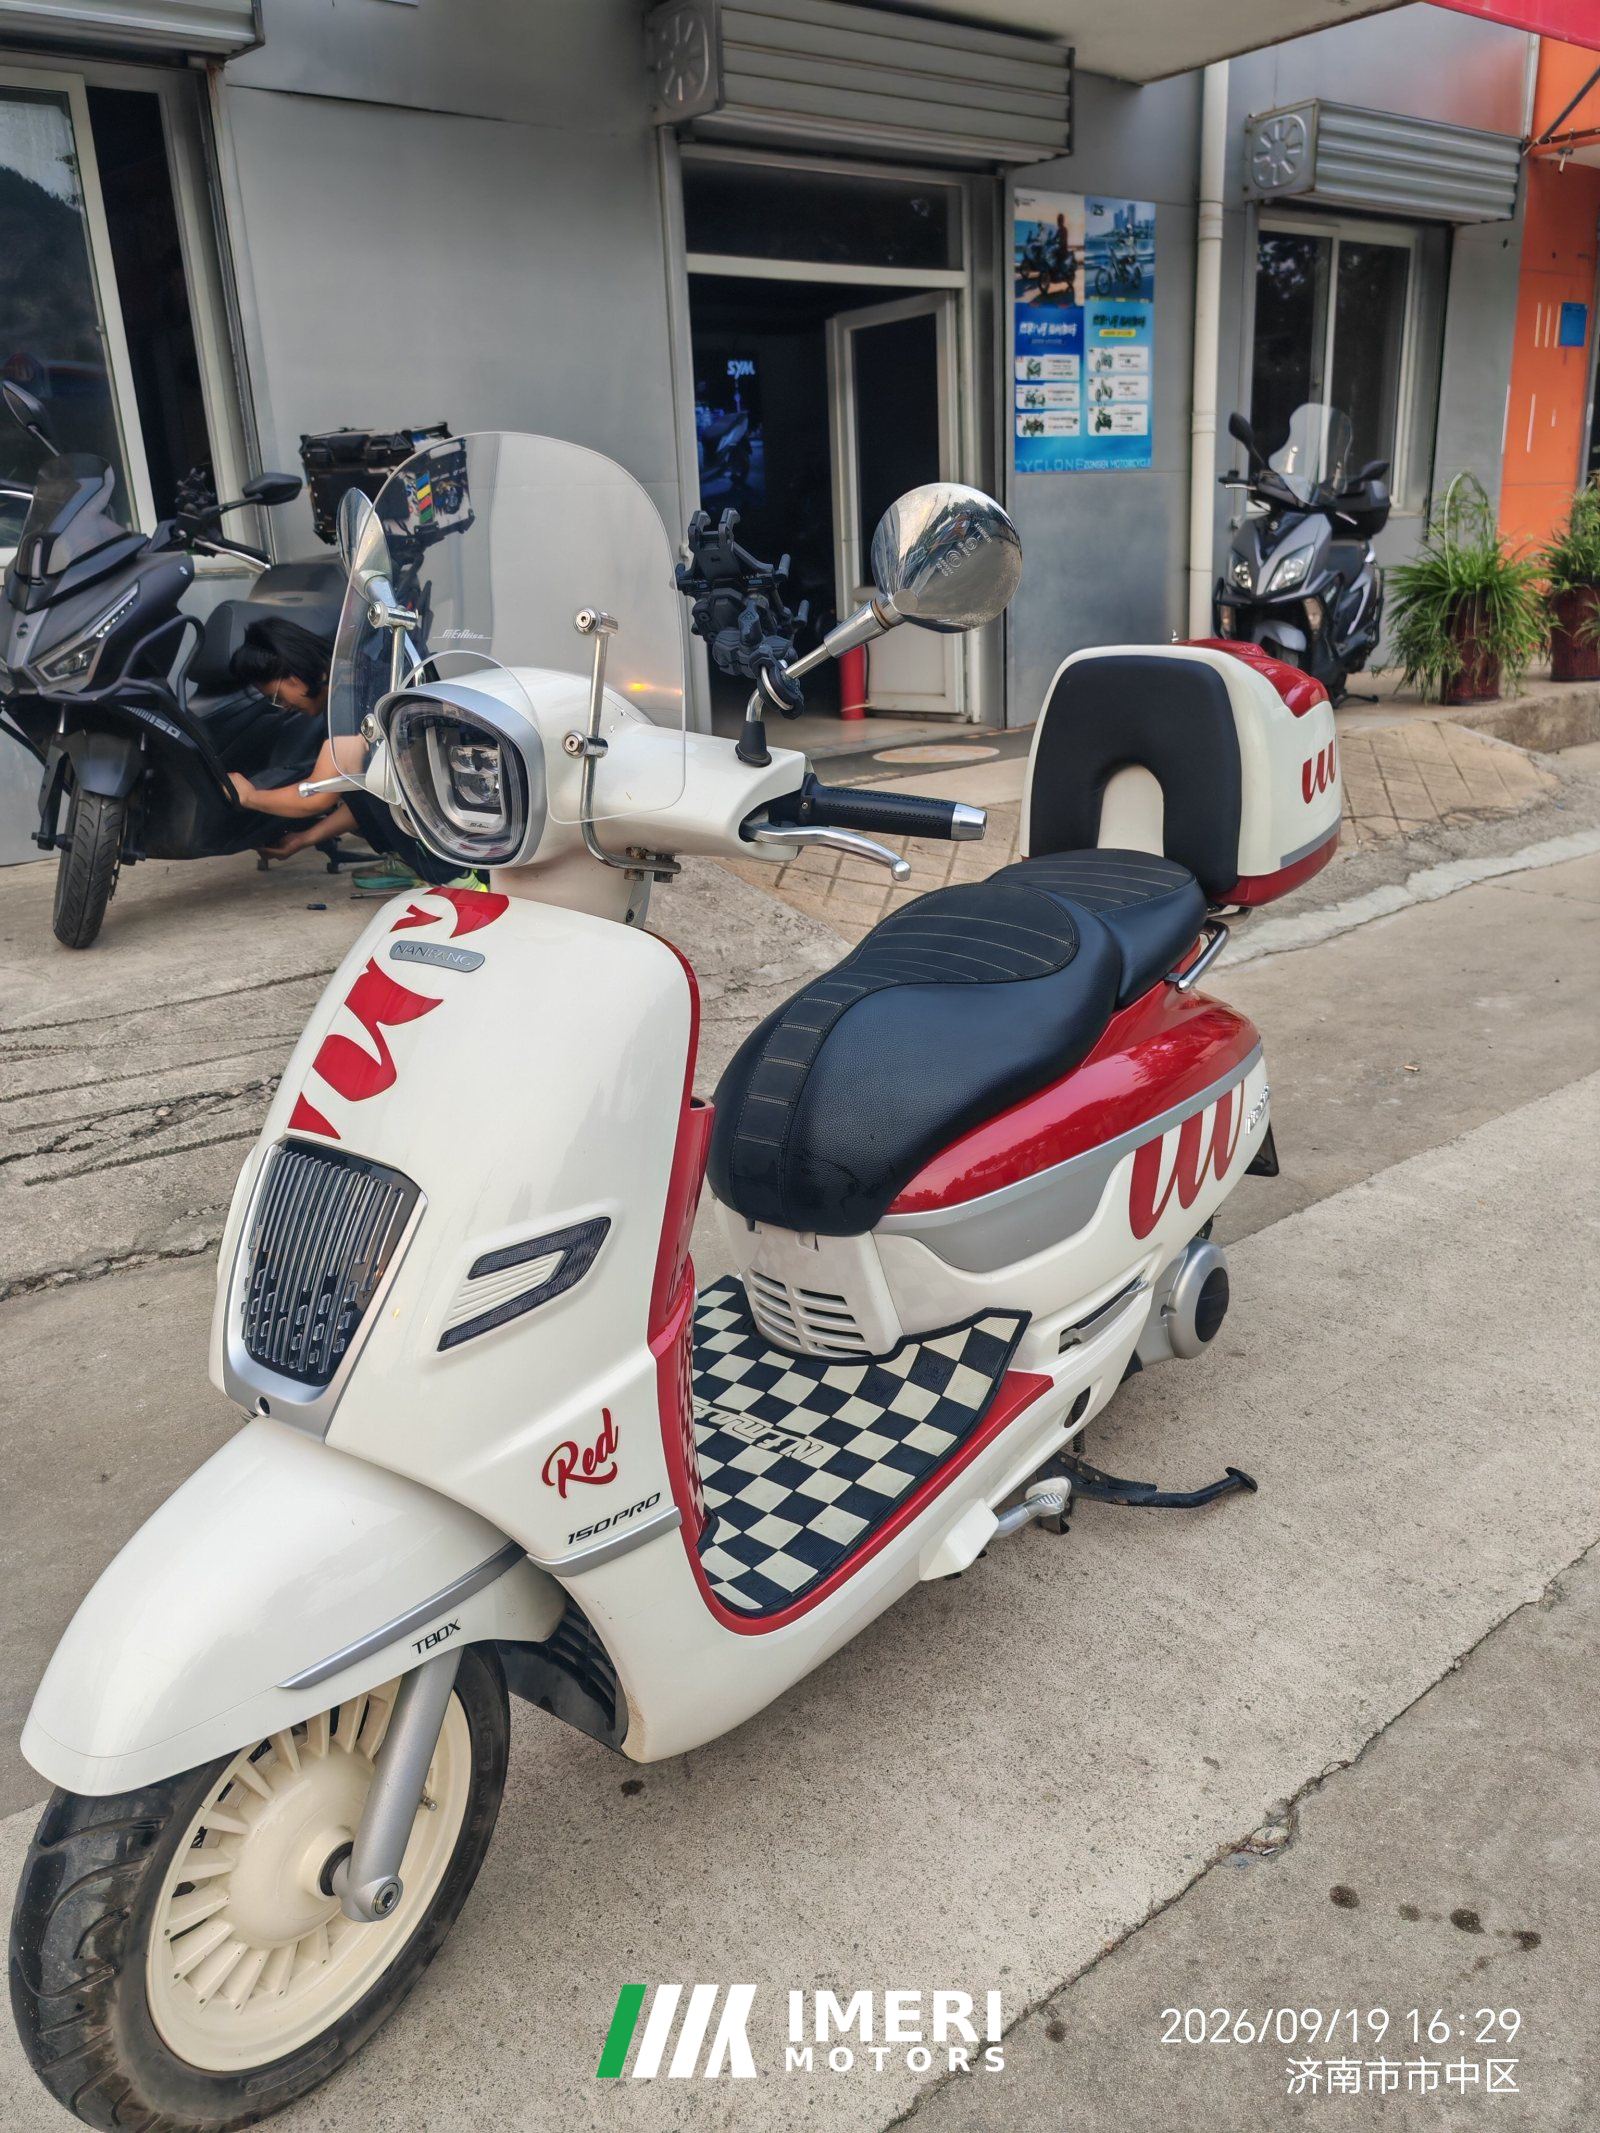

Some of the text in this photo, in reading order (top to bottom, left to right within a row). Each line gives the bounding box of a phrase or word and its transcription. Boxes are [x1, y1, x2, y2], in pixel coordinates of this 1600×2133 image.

[727, 359, 756, 379] SYM
[395, 944, 474, 967] NANFANG
[541, 1407, 619, 1499] Red
[411, 1618, 462, 1655] TBOX
